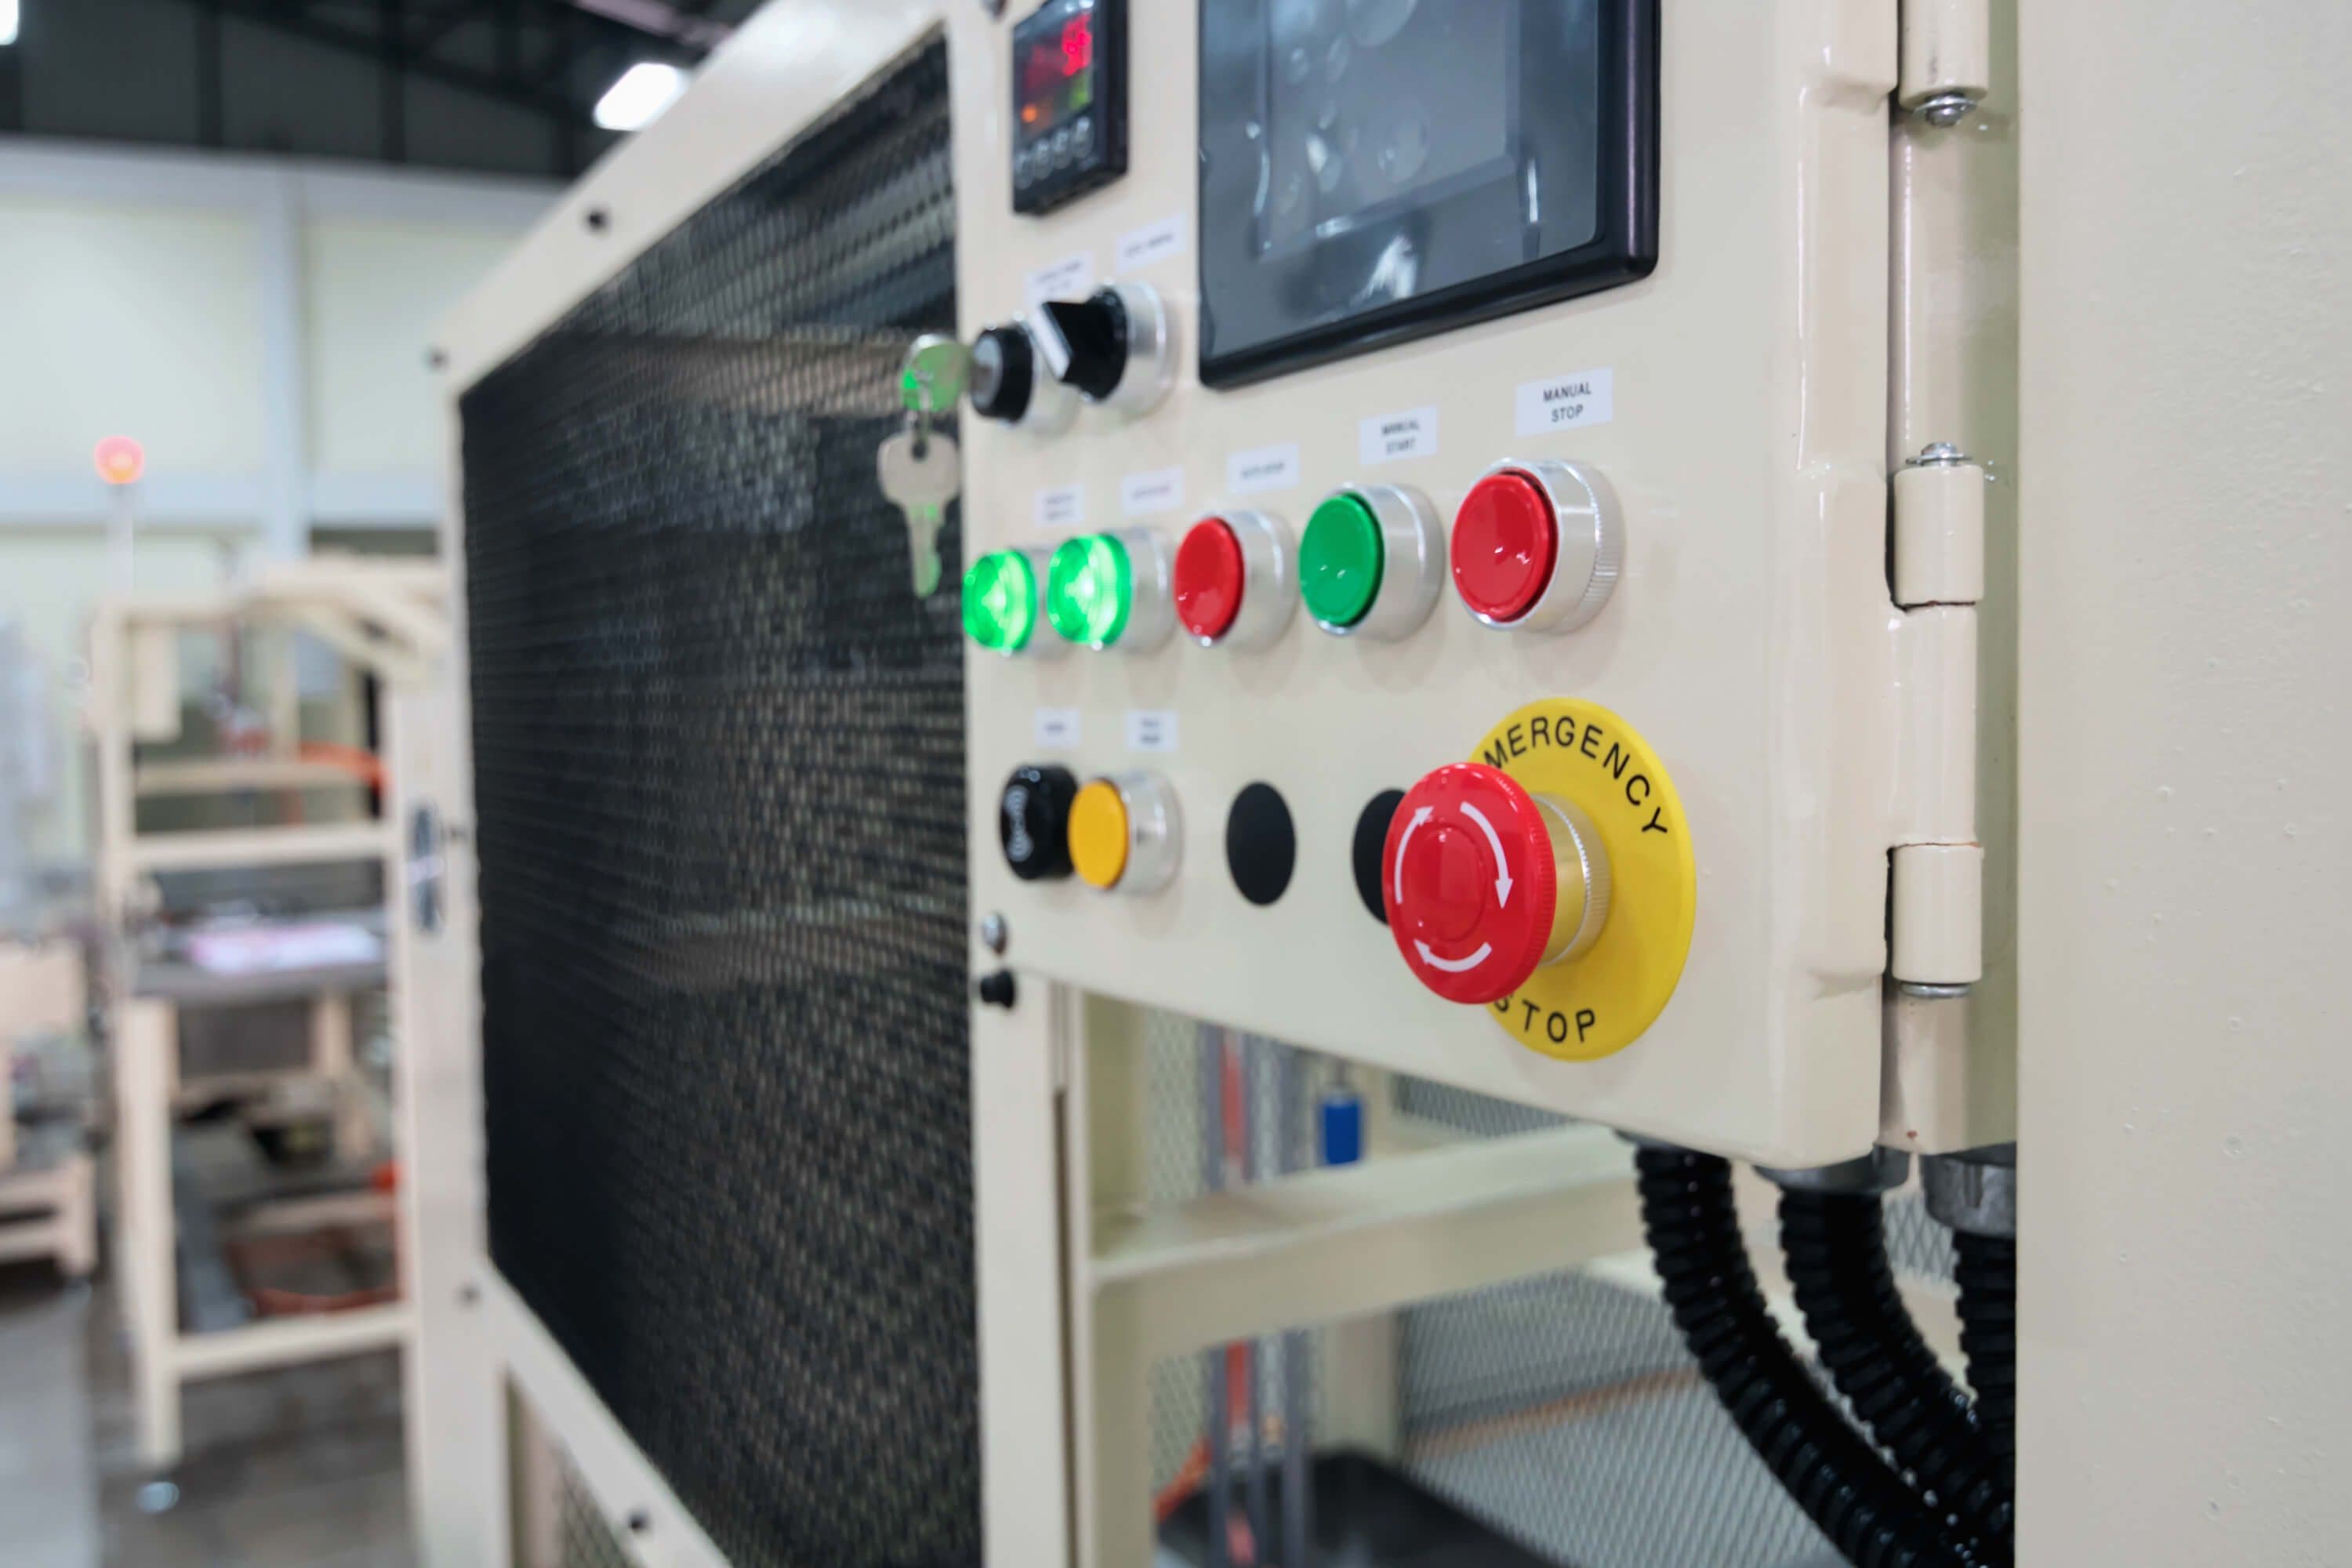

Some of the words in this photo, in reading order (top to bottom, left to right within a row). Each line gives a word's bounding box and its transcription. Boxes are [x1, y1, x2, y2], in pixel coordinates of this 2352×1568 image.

[1543, 382, 1592, 402] MANUAL
[1551, 404, 1584, 423] STOP
[1483, 716, 1668, 833] MERGENCY
